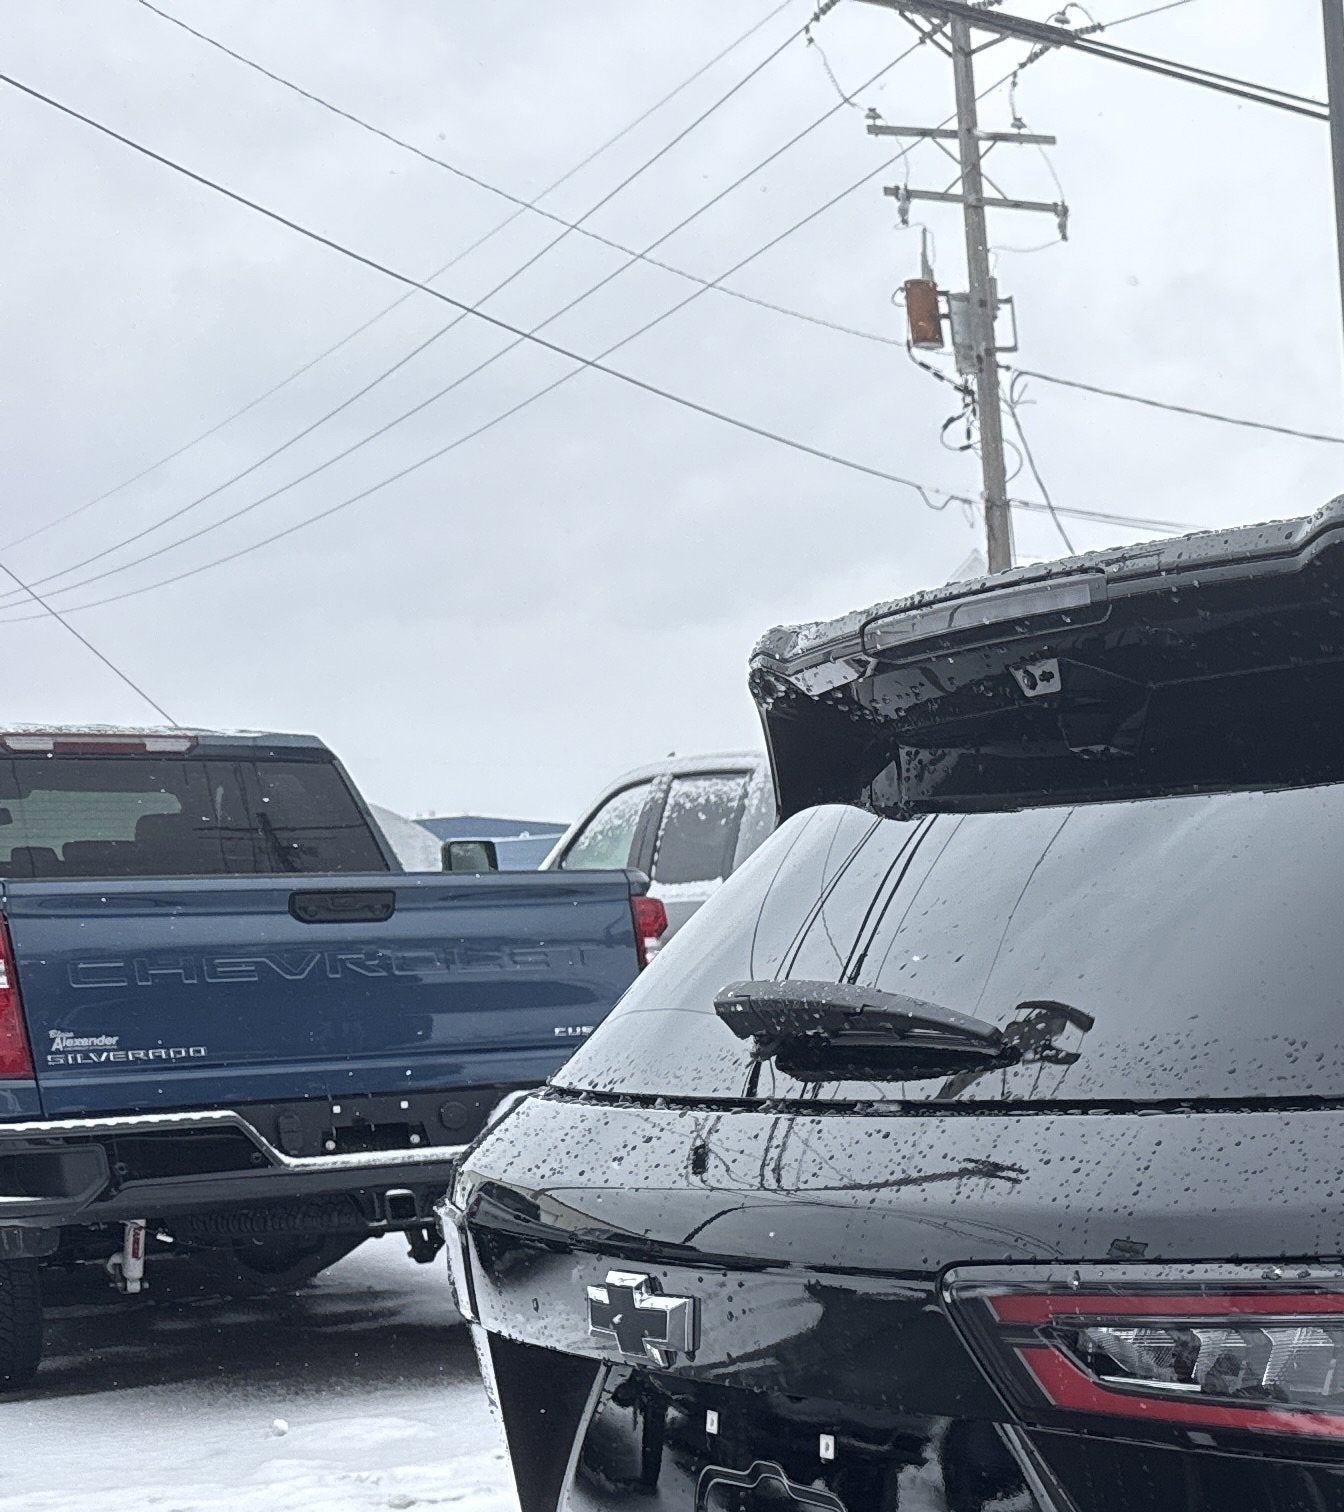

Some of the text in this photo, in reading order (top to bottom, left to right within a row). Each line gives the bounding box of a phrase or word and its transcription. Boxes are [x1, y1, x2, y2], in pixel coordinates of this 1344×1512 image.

[67, 945, 601, 988] CHEVROLET
[51, 1035, 119, 1051] Alexander
[47, 1046, 208, 1065] SILVERADO
